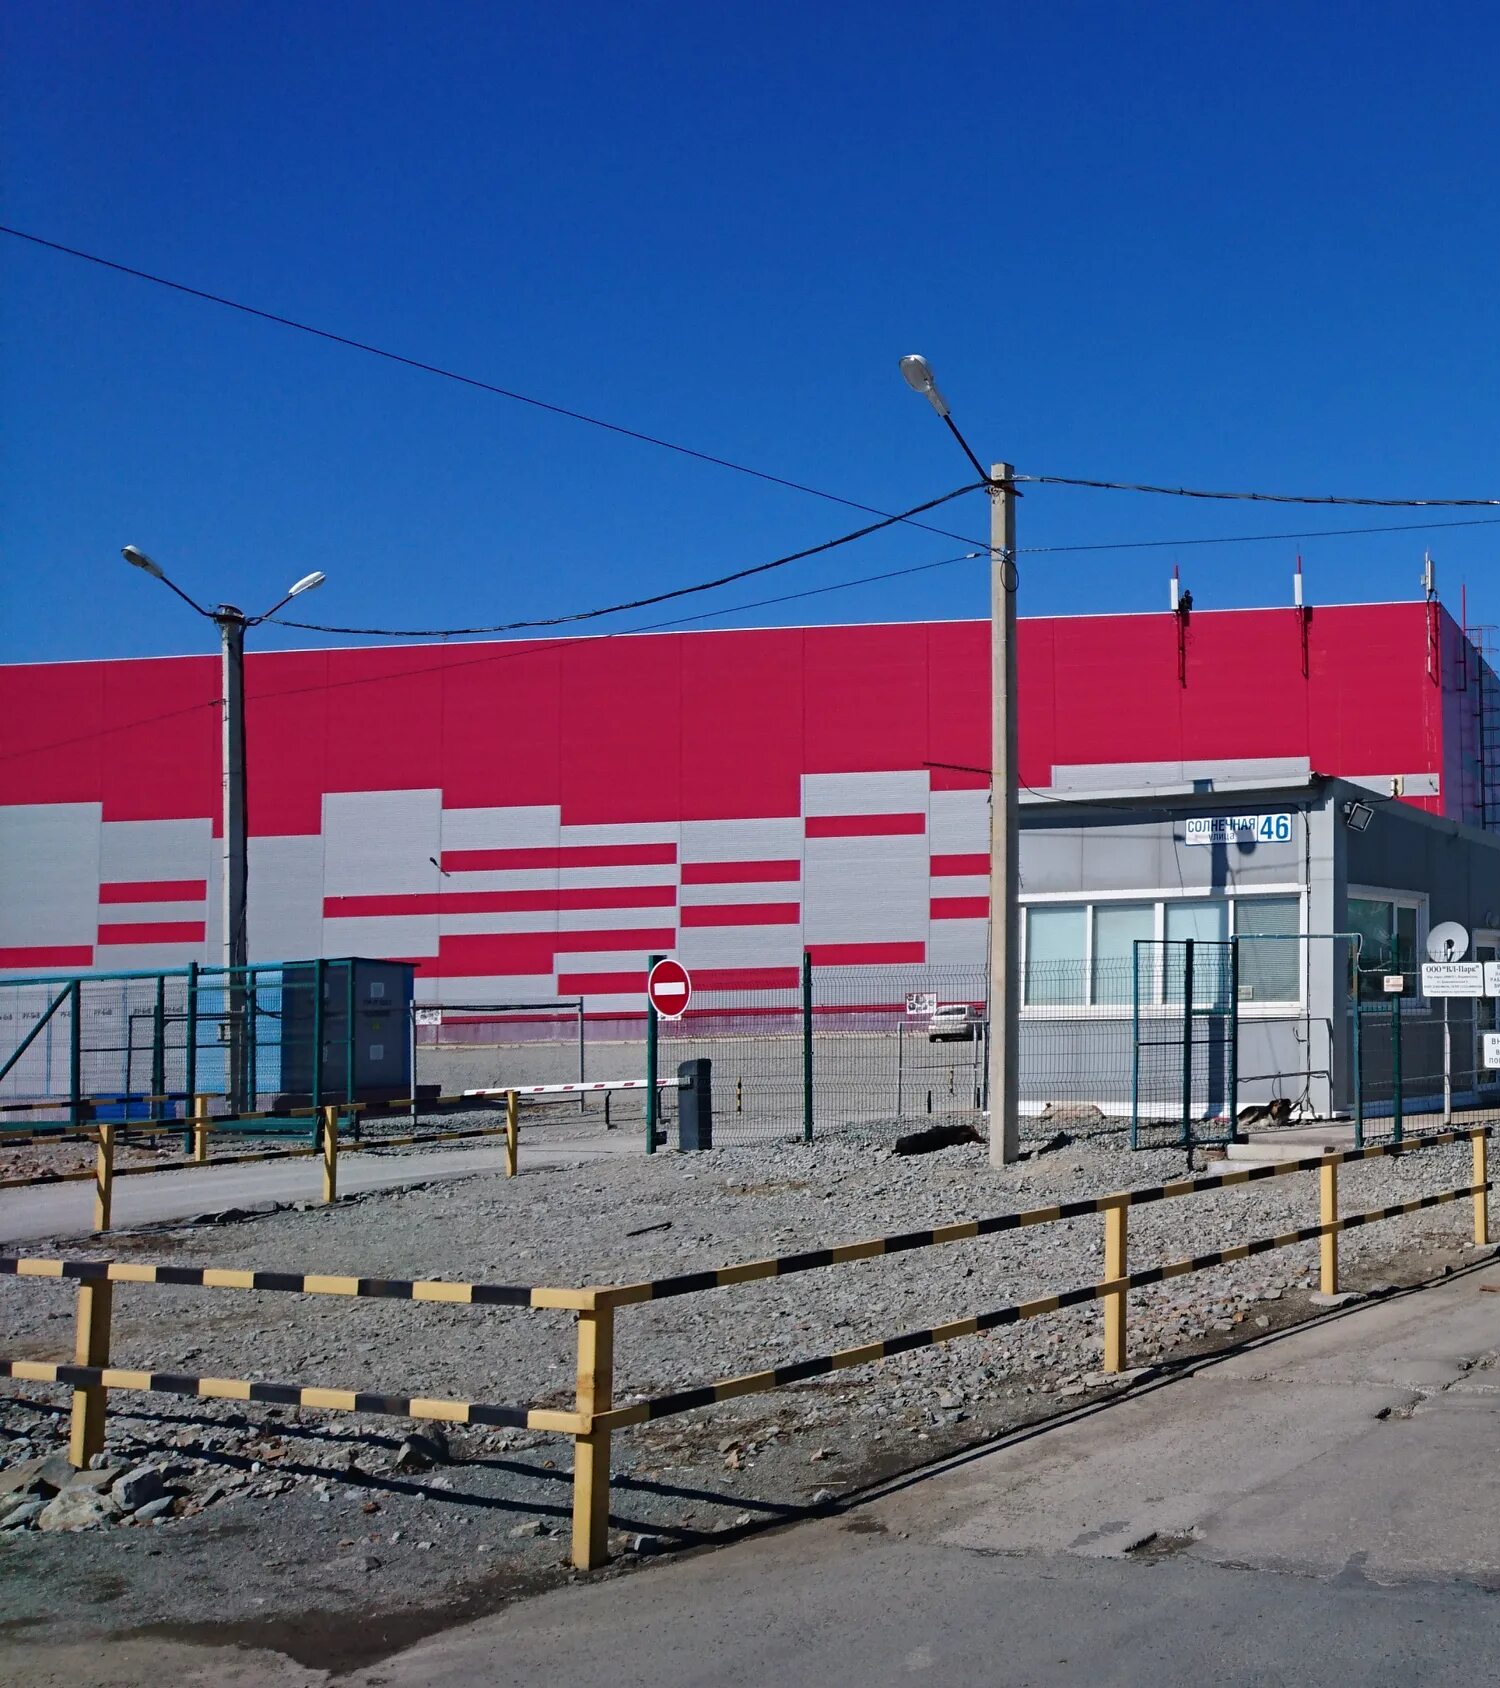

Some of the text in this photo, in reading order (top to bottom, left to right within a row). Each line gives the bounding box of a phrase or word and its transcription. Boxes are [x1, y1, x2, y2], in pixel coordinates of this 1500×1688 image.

[1187, 815, 1289, 840] СОЛНЕЧНАЯ 46
[1208, 832, 1235, 841] улица
[1425, 965, 1442, 973] ООО
